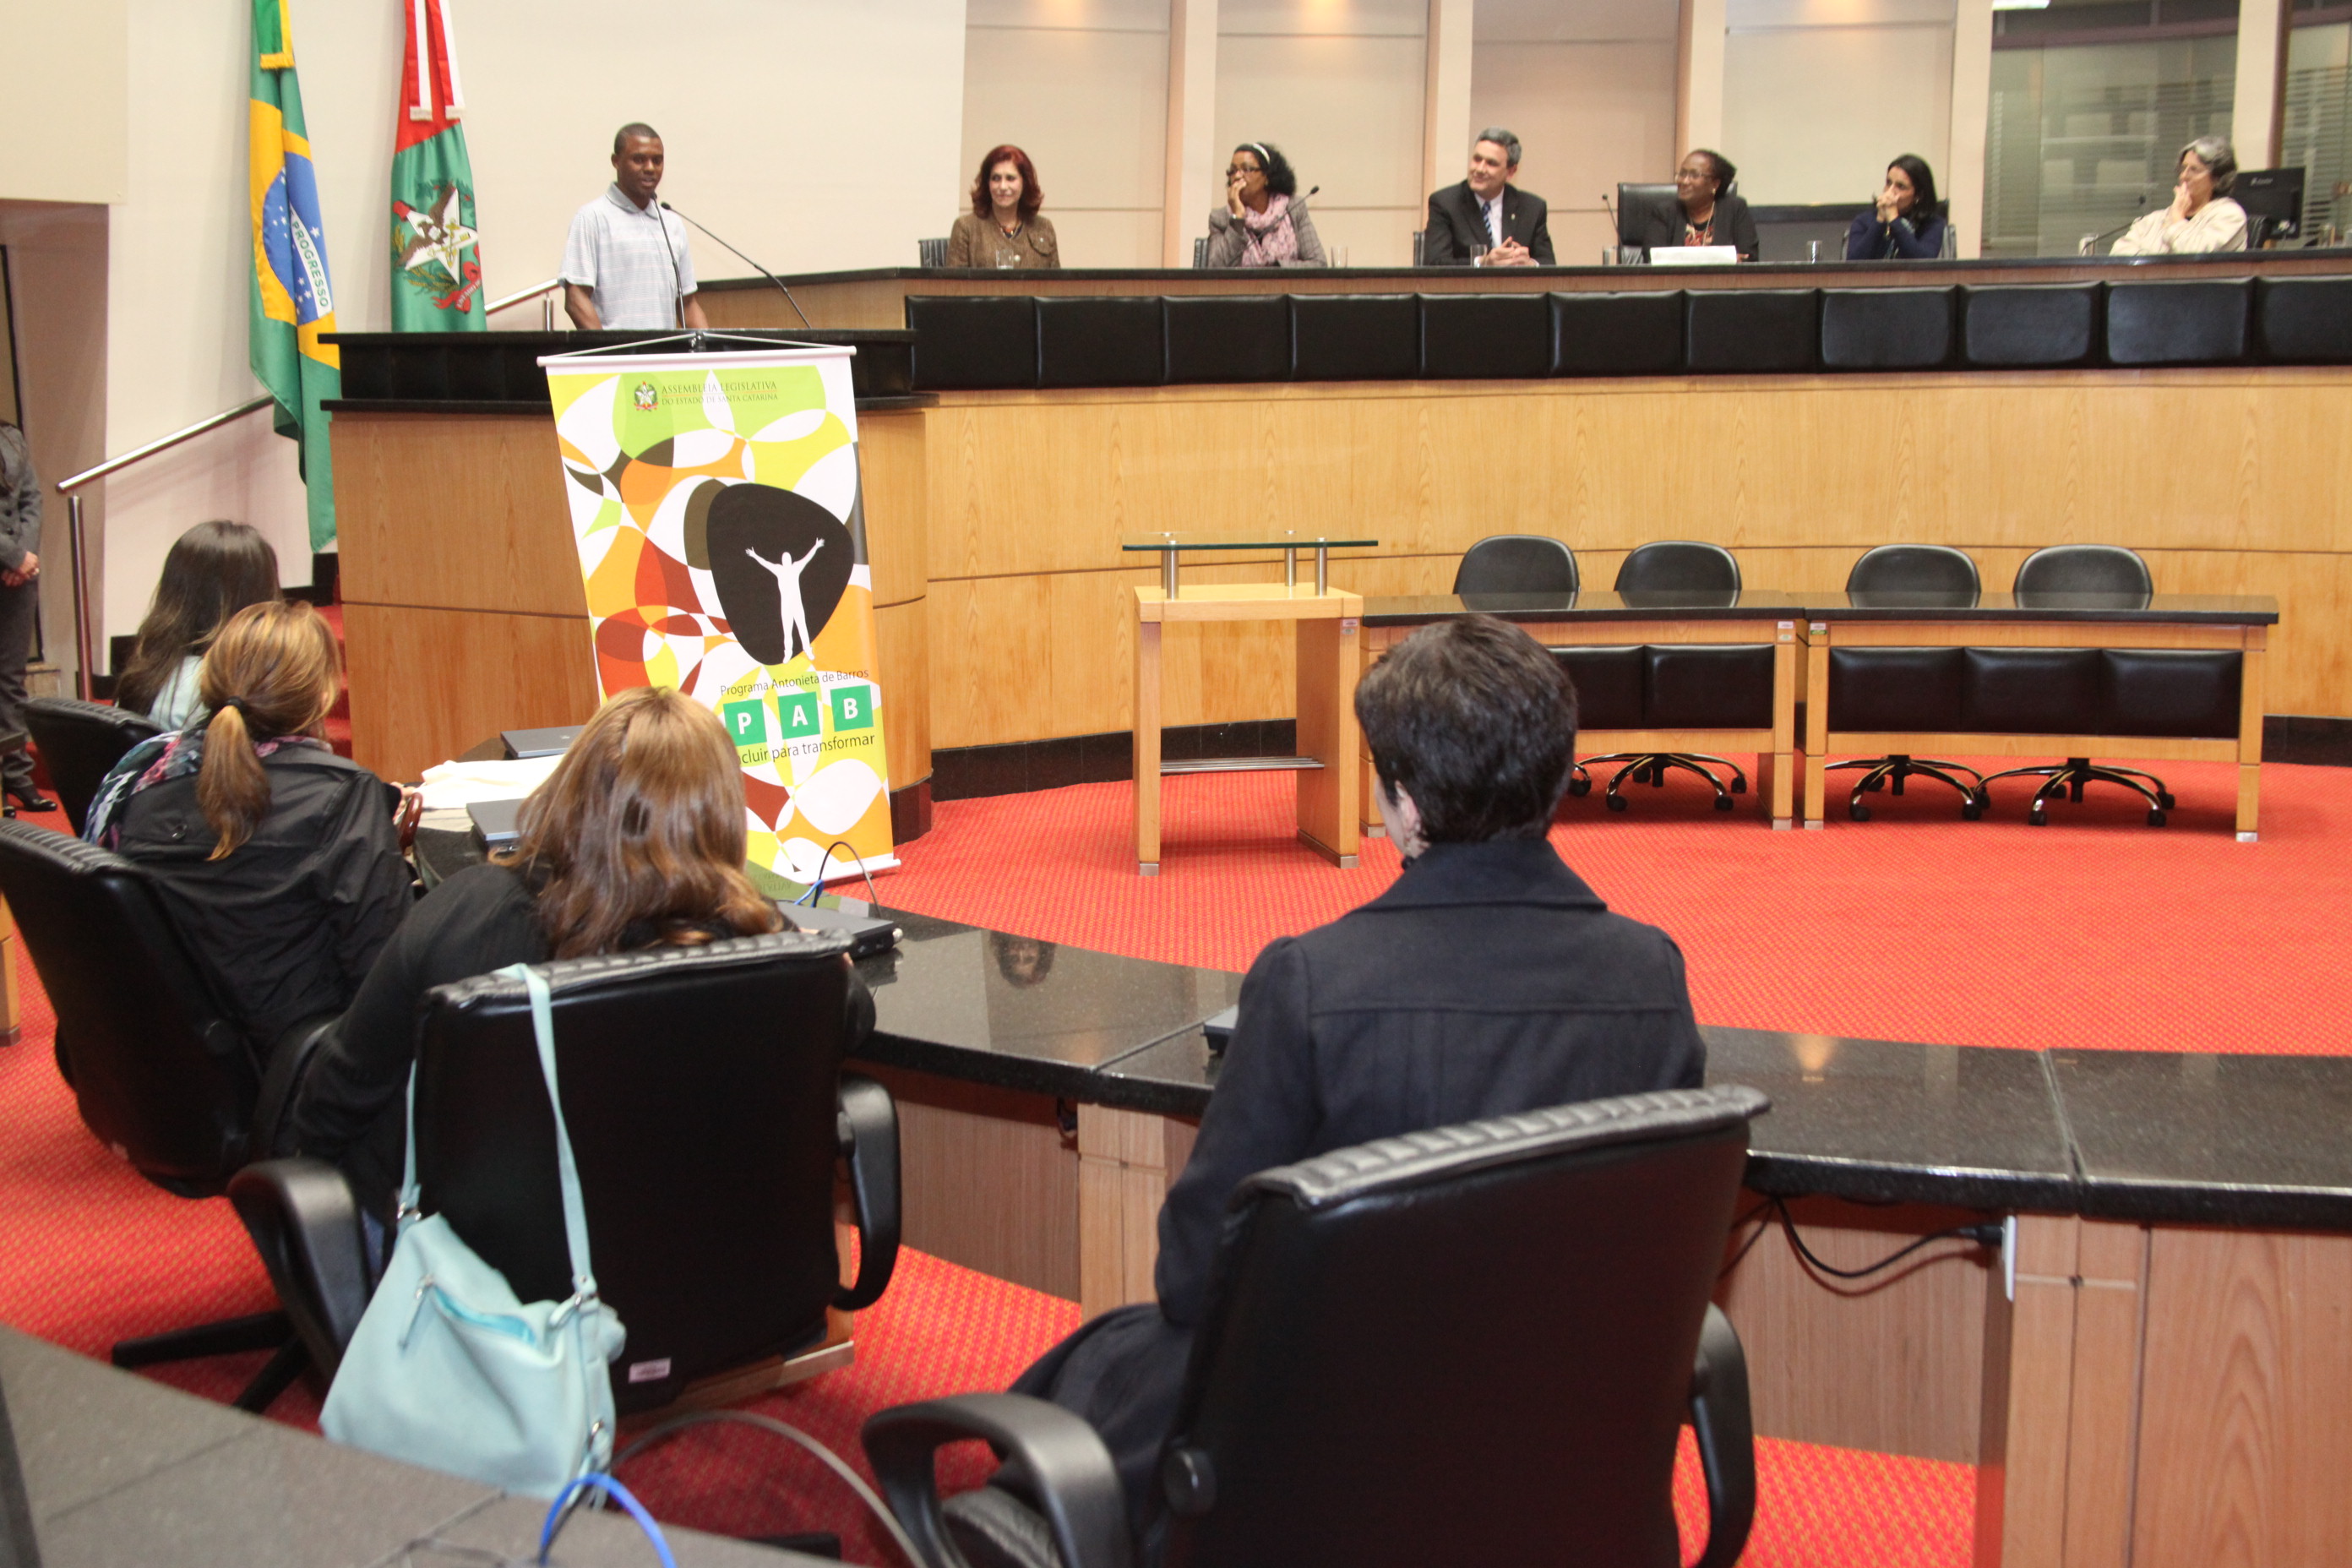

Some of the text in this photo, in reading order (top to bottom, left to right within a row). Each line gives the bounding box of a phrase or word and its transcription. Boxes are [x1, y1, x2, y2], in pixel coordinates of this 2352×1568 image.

[292, 220, 329, 307] PROGRESSO
[662, 381, 777, 394] ASSEMBLEIA LEGISLATIVA
[676, 396, 704, 405] ESTADO
[706, 395, 715, 404] DE
[718, 395, 740, 403] SANTA
[743, 394, 778, 402] CATARINA
[721, 669, 869, 696] Programa Antonieta de Barros
[739, 734, 875, 764] cluir para transformar
